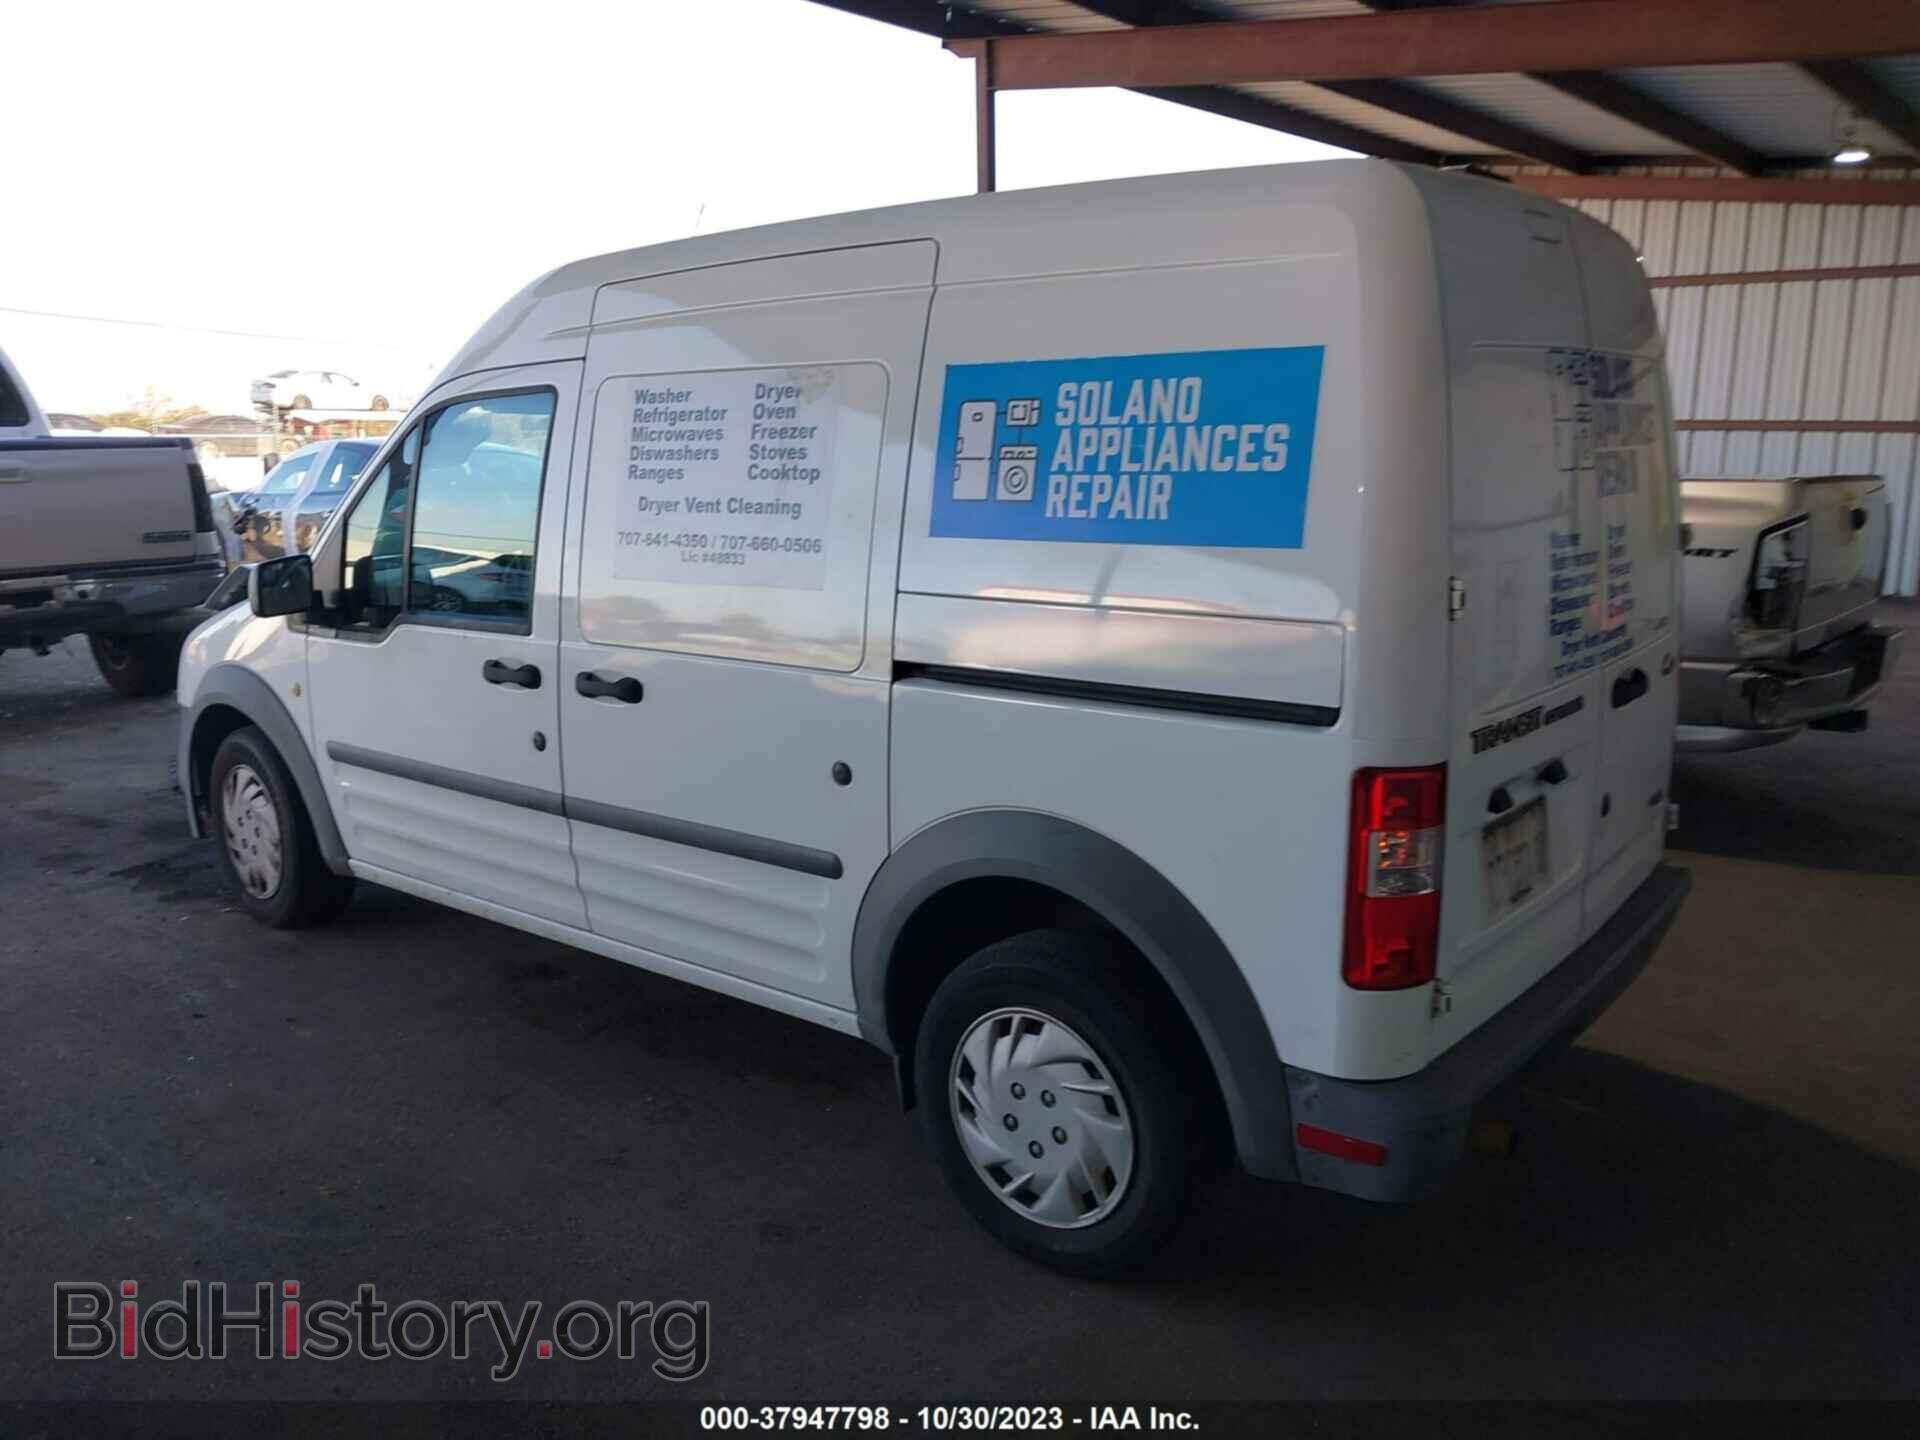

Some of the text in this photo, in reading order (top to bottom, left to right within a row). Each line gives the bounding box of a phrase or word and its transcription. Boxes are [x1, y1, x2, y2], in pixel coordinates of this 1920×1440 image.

[635, 388, 692, 405] Washer
[754, 383, 801, 404] Dryer
[1054, 377, 1203, 426] SOLANO
[633, 406, 728, 427] Refrigerator
[753, 403, 796, 420] Oven
[631, 427, 724, 443] Microwaves
[750, 424, 817, 440] Freezer
[629, 446, 719, 461] Diswashers
[748, 444, 808, 460] Stoves
[1050, 423, 1290, 473] APPLIANCES
[628, 464, 685, 484] Ranges
[747, 464, 821, 485] Cooktop
[1045, 474, 1173, 521] REPAIR
[638, 496, 802, 520] Dryer Vent Cleaning
